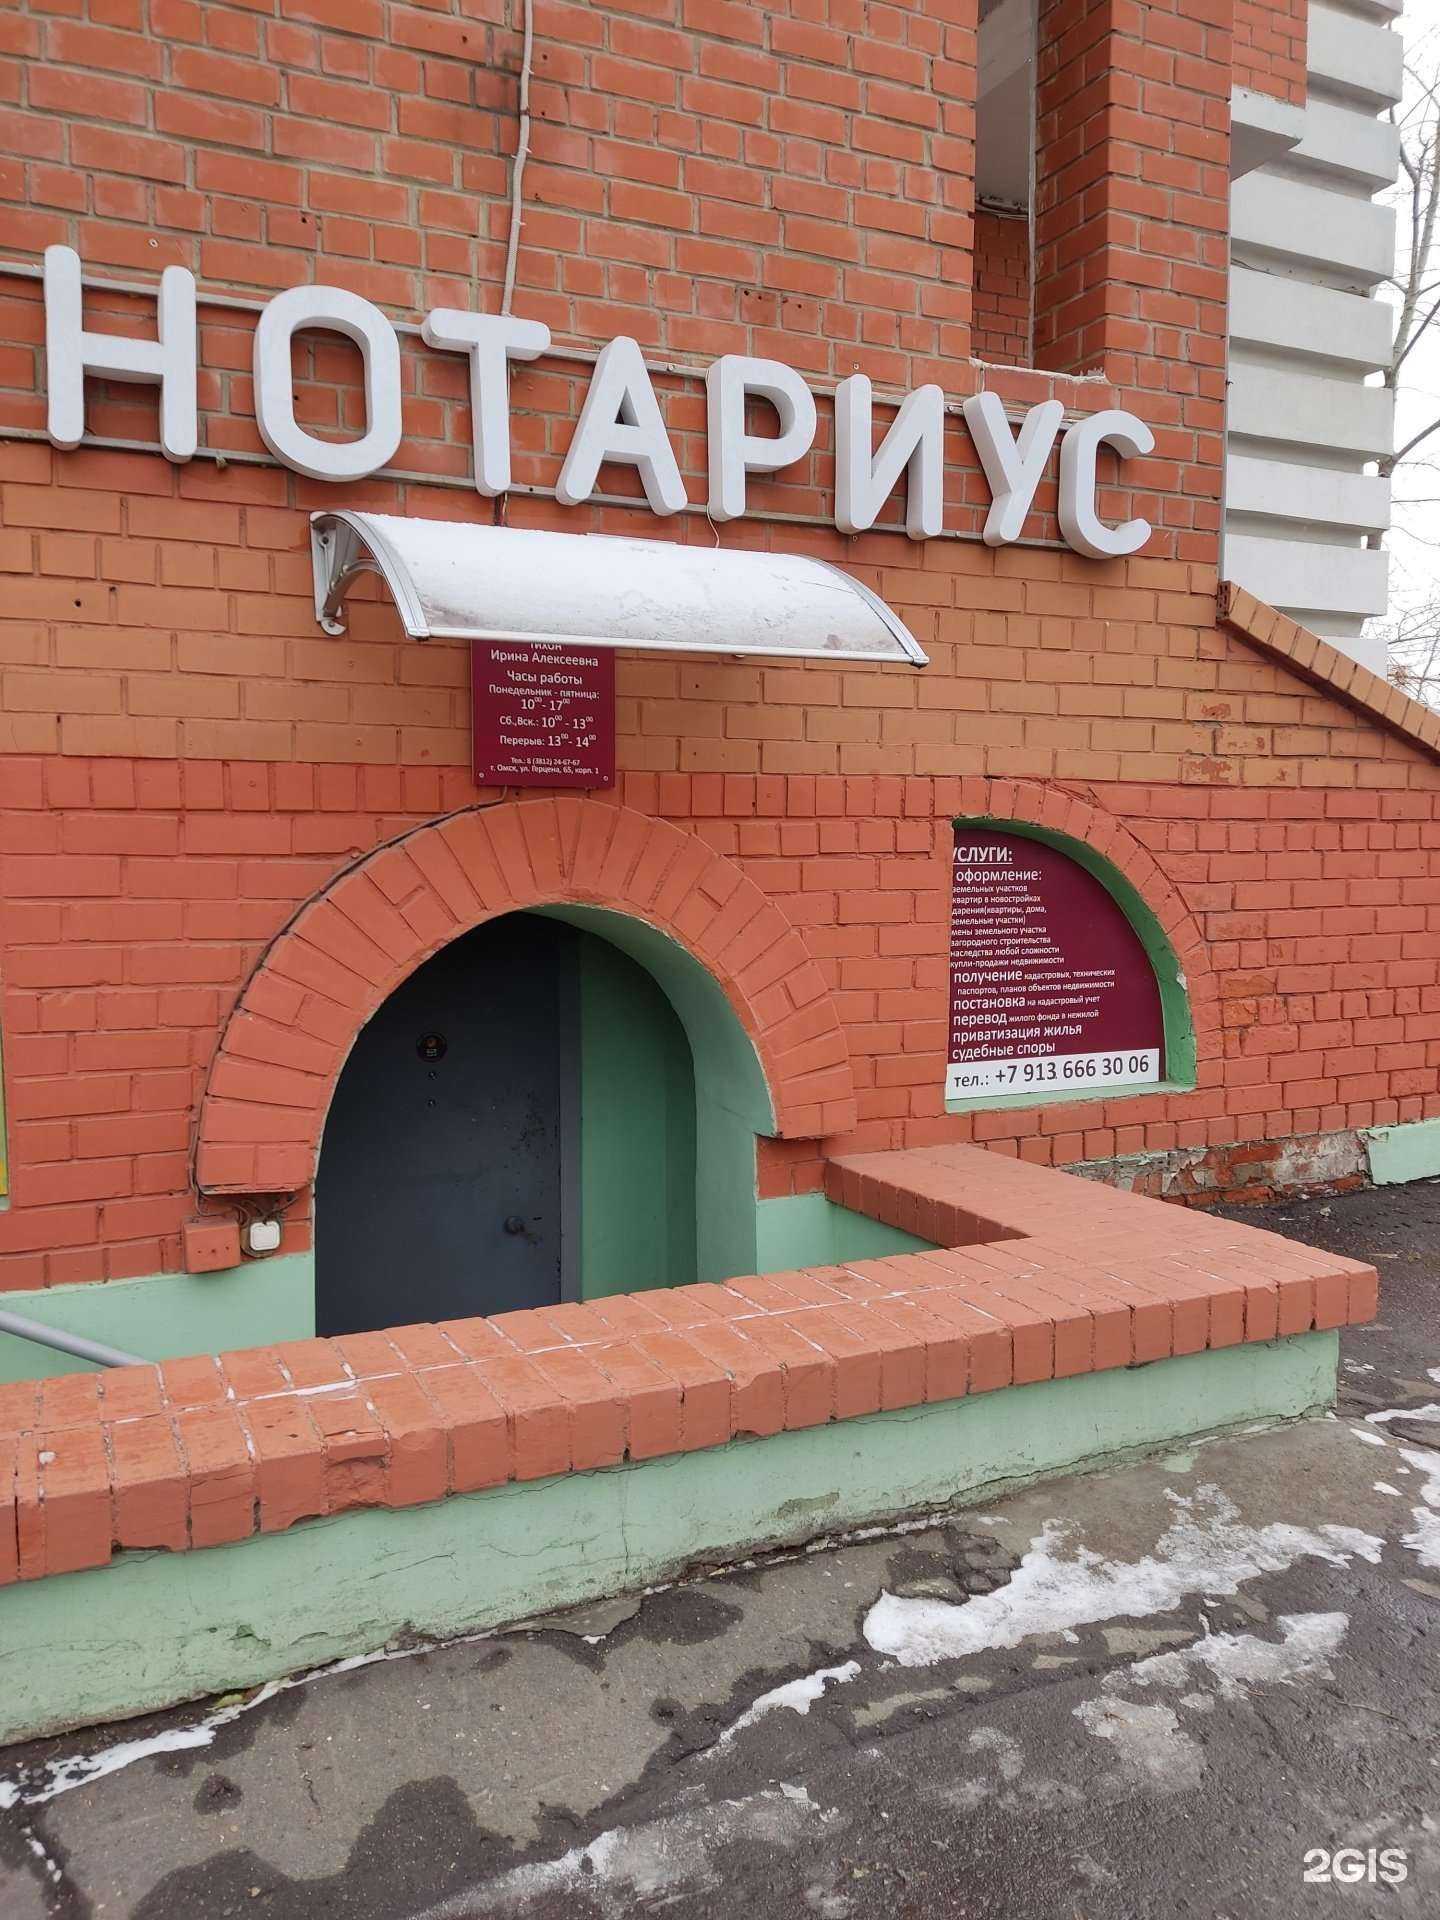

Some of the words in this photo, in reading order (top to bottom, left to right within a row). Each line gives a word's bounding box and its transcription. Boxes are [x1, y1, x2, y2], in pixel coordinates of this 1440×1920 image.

[44, 244, 1155, 560] НОТАРИУС
[491, 649, 528, 663] Ирина
[532, 652, 599, 667] Алексеевна
[507, 670, 536, 681] Часы
[540, 672, 583, 685] работы
[489, 684, 552, 696] Понедельник
[560, 690, 600, 700] пятница:
[500, 735, 545, 747] Перерыв:
[956, 868, 1042, 884] оформление:
[996, 885, 1028, 893] участков
[952, 896, 982, 905] квартир
[990, 894, 1041, 904] новостройках
[1026, 906, 1047, 914] дома,
[995, 915, 1026, 926] участки)
[974, 928, 1018, 936] земельного
[1020, 927, 1047, 936] участка
[951, 938, 998, 948] загородного
[999, 937, 1051, 947] строительства
[950, 949, 993, 958] наследства
[995, 947, 1020, 956] любой
[1021, 946, 1060, 955] сложности
[950, 958, 1009, 969] купли-продажи
[1010, 956, 1065, 966] недвижимости
[953, 969, 1023, 985] получение
[1024, 970, 1071, 980] кадастровых,
[1072, 968, 1116, 978] технических
[957, 986, 998, 996] паспортов,
[1000, 985, 1026, 993] планов
[1028, 983, 1062, 992] объектов
[1062, 980, 1115, 990] недвижимости
[953, 996, 1026, 1011] постановка
[1037, 996, 1084, 1007] кадастровый
[1085, 994, 1101, 1004] учет
[953, 1012, 1008, 1028] перевод
[1008, 1014, 1036, 1023] жилого
[1036, 1012, 1060, 1023] фонда
[1067, 1009, 1100, 1019] нежилой
[953, 1026, 1041, 1045] приватизация
[1043, 1024, 1083, 1037] жилья
[952, 1043, 1014, 1061] судебные
[1016, 1041, 1056, 1058] споры
[953, 1072, 990, 1088] тел.:
[995, 1065, 1018, 1084] +7
[1023, 1062, 1057, 1081] 913
[1063, 1059, 1097, 1079] 666
[1102, 1056, 1124, 1076] 30
[1128, 1054, 1150, 1074] 06
